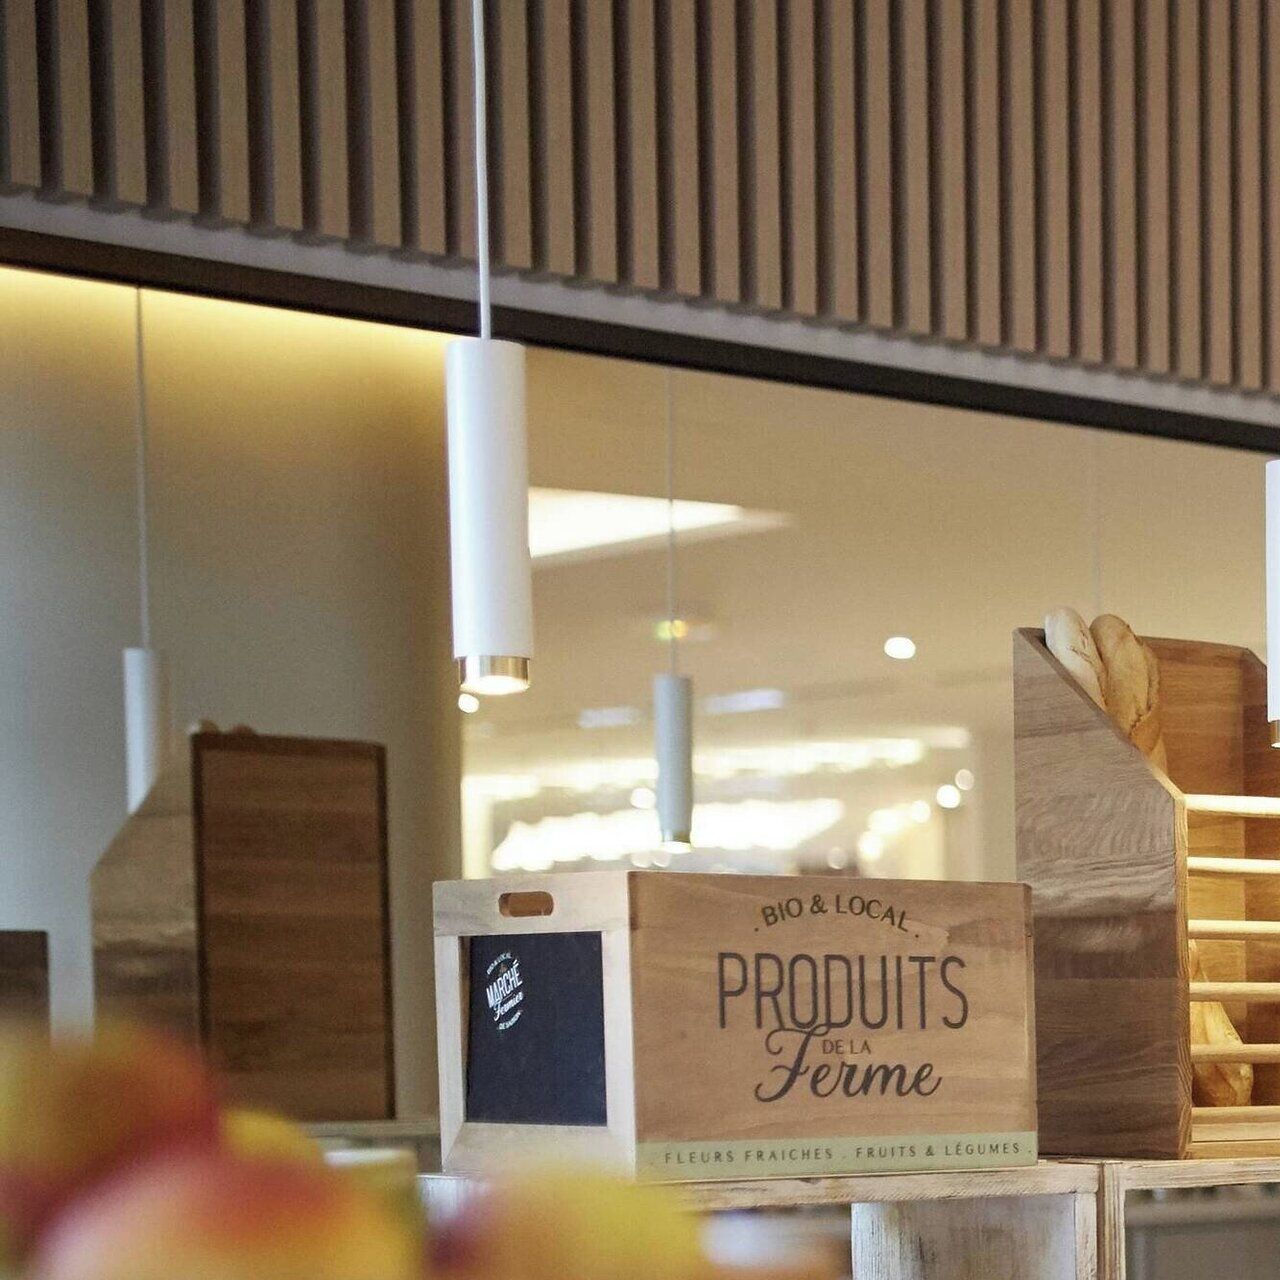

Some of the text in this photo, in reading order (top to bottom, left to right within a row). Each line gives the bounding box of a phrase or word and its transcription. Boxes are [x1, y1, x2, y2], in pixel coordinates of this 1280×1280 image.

[761, 893, 909, 933] BIO & LOCAL
[486, 959, 523, 1008] MARCHÉ
[717, 951, 969, 1030] PRODUITS
[754, 1022, 943, 1103] Ferme
[822, 1038, 872, 1056] DE LA
[664, 1141, 1021, 1165] FLEURS FRAICHES FRUITS & LÉGUMES
